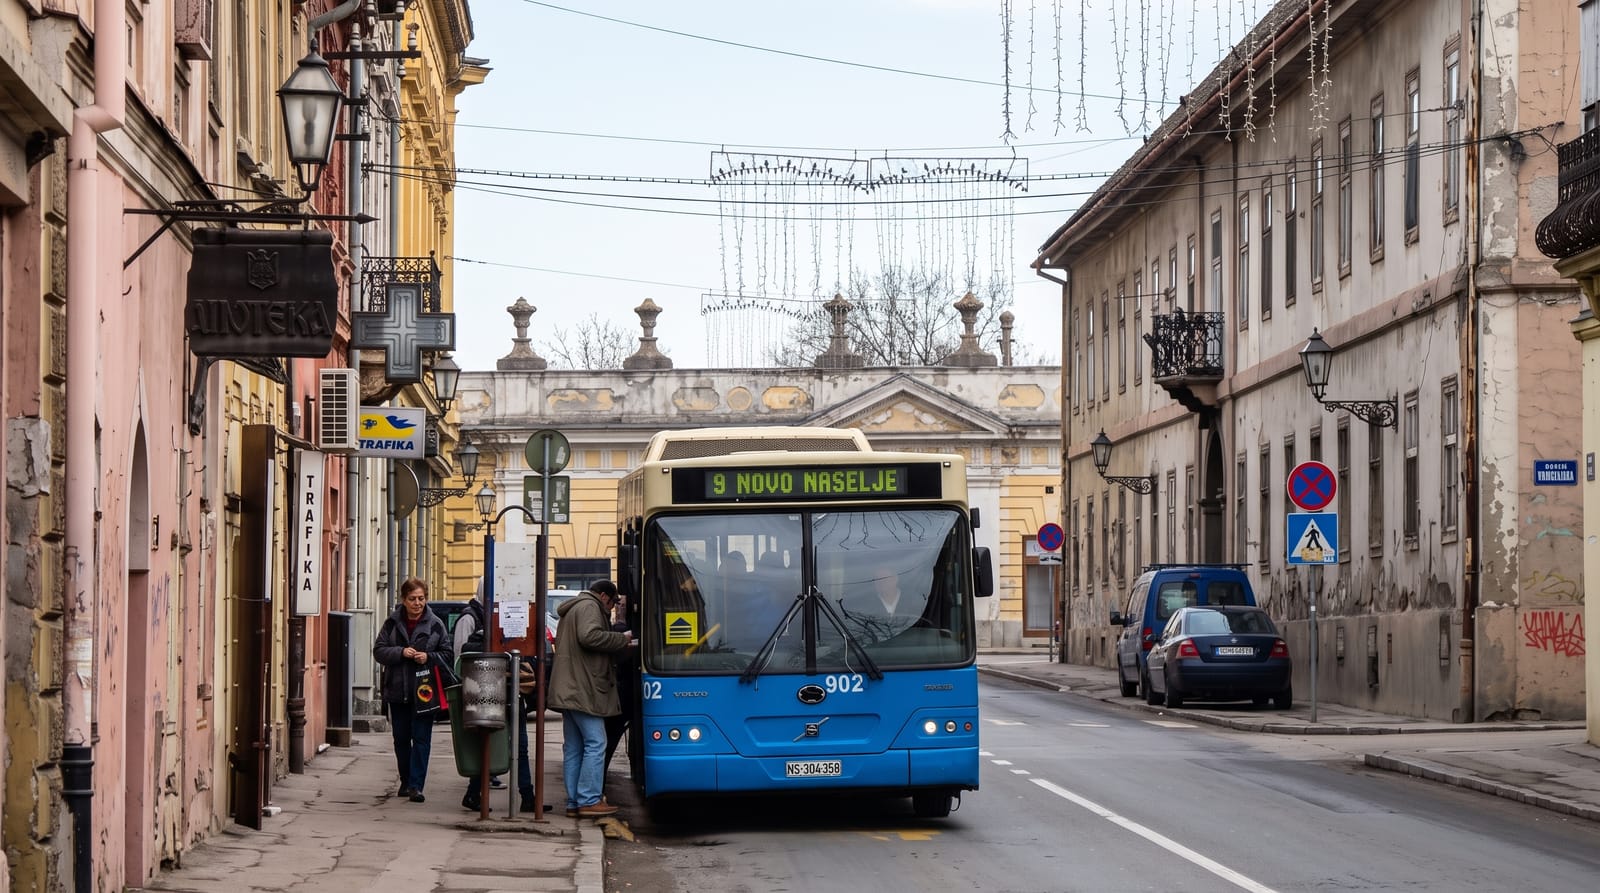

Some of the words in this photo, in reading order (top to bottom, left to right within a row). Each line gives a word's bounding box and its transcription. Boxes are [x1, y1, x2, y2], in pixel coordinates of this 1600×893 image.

[359, 440, 414, 450] TRAFIKA
[713, 473, 725, 494] 9
[737, 472, 793, 494] NOVO
[804, 470, 897, 493] NASELJE
[303, 475, 315, 591] TRAFIKA
[825, 674, 864, 693] 902
